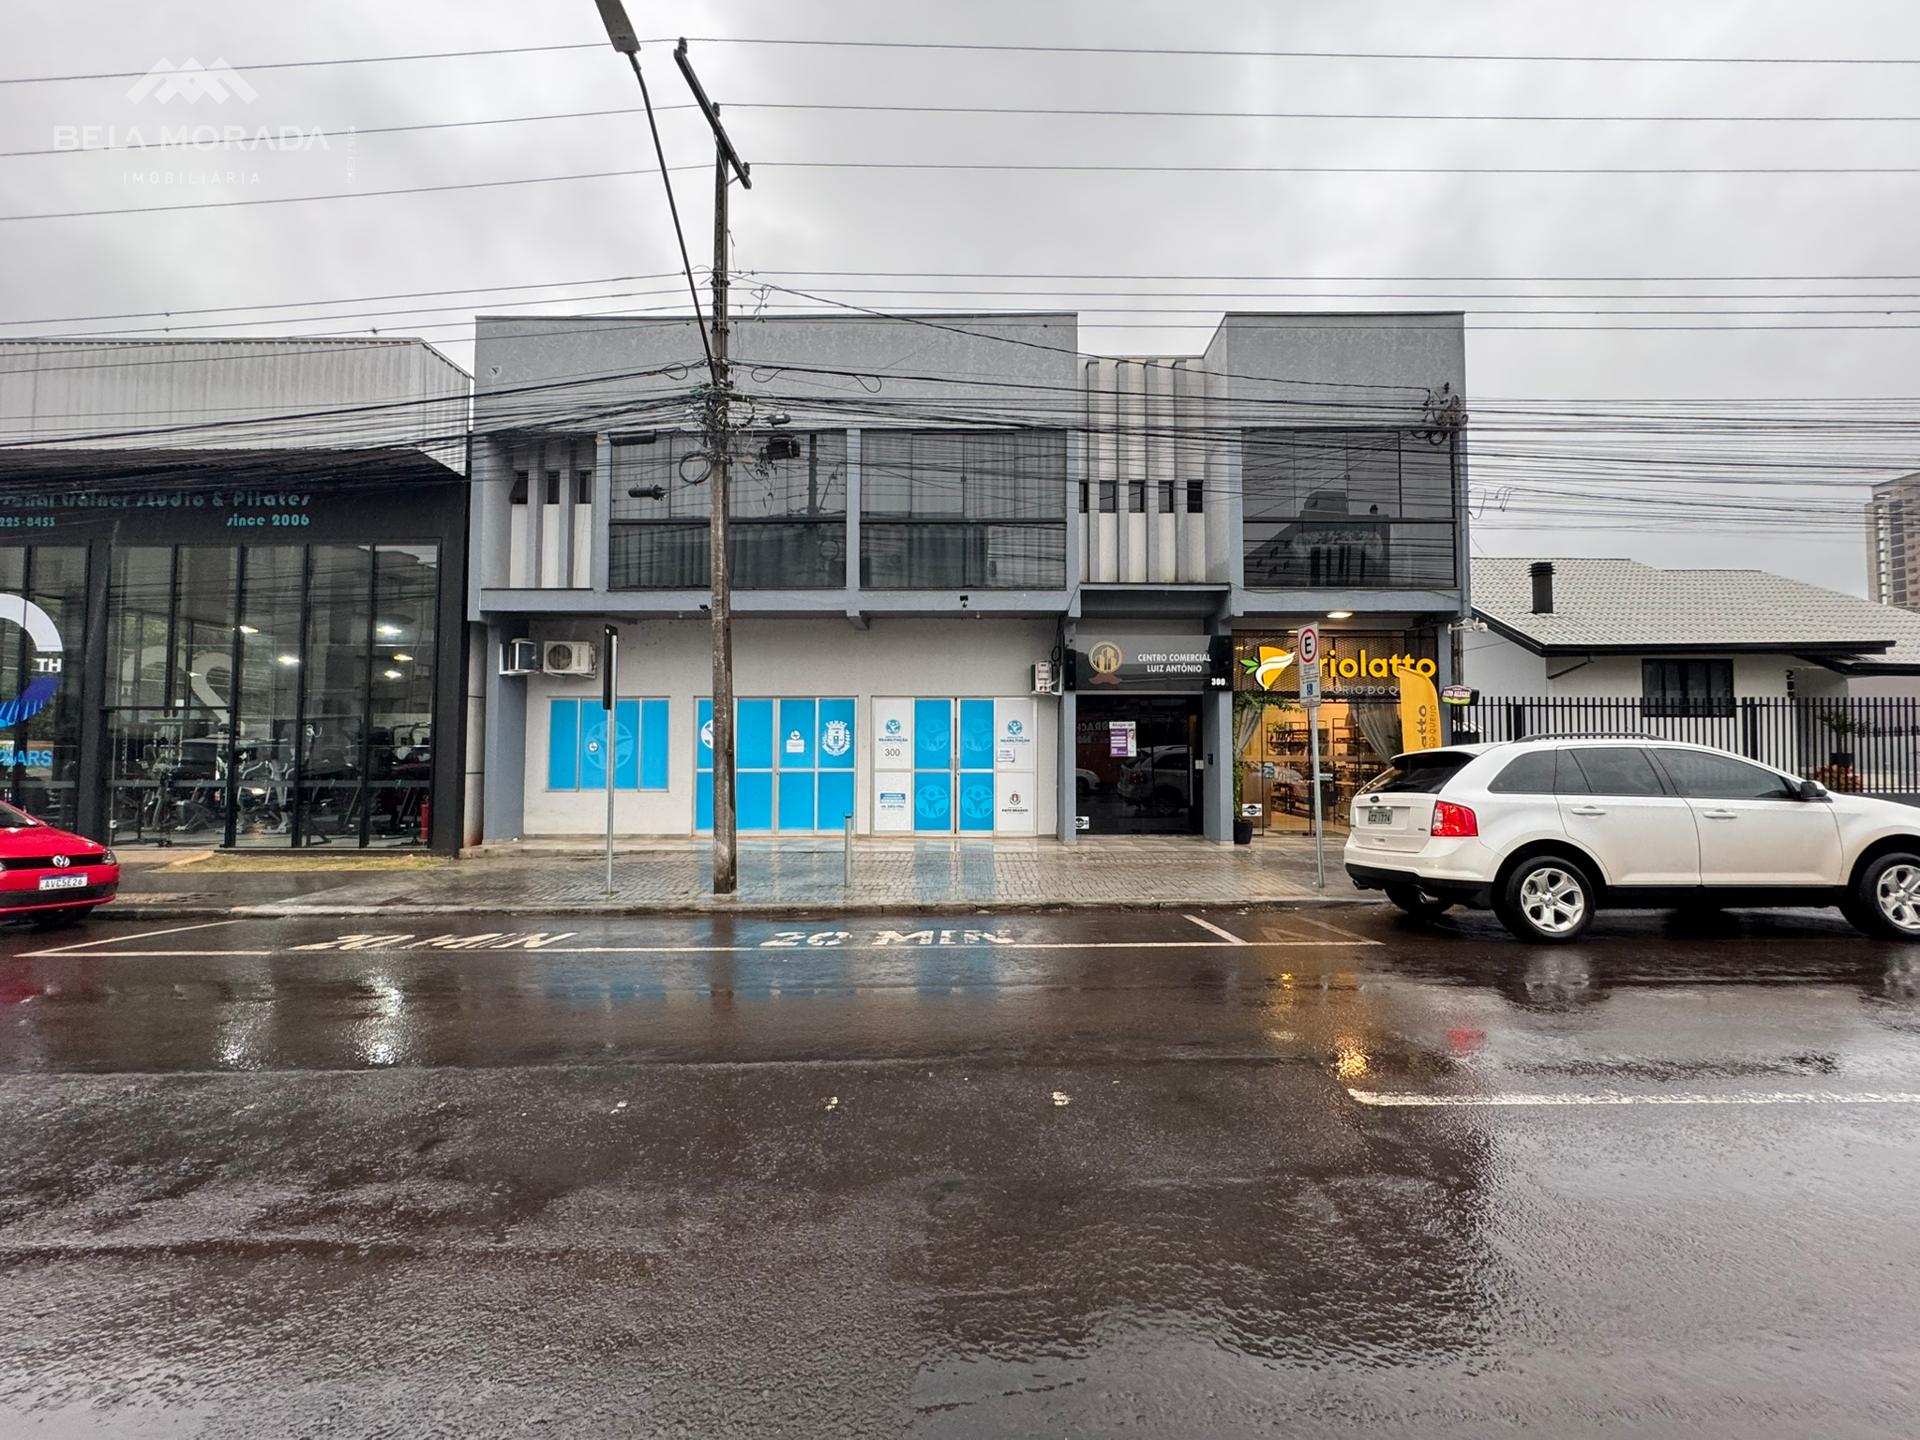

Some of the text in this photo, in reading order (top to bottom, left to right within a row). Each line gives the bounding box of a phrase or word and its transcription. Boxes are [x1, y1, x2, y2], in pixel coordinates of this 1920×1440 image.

[234, 491, 310, 507] Pilates
[226, 513, 310, 527] since 2006
[1304, 636, 1312, 654] E
[1137, 653, 1212, 662] CENTRO COMERCIAL
[33, 658, 62, 673] TH
[1147, 662, 1203, 673] LUIZ ANTÔNIO
[884, 748, 901, 757] 300
[760, 929, 1016, 947] 20 MIN
